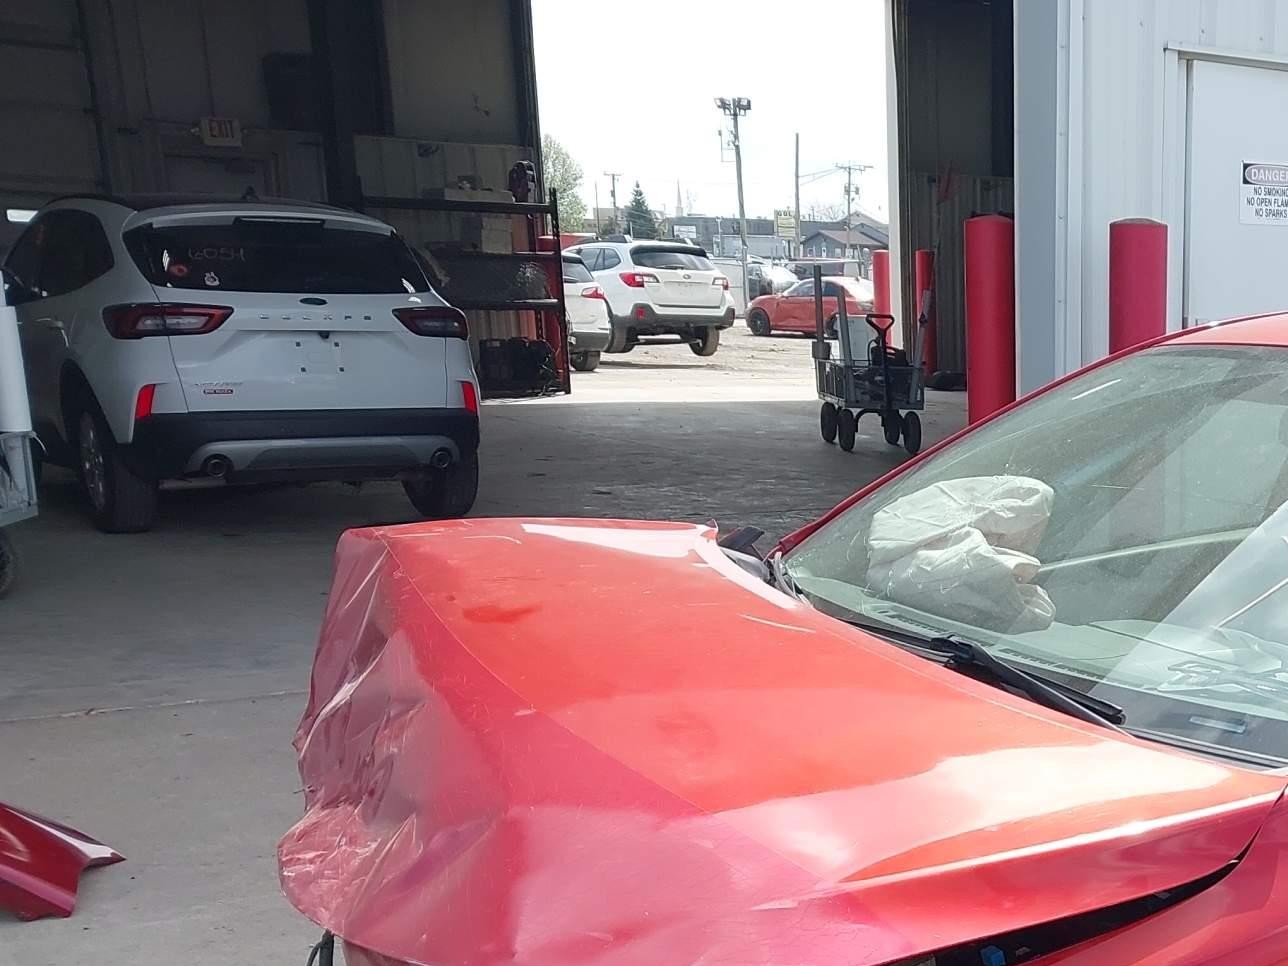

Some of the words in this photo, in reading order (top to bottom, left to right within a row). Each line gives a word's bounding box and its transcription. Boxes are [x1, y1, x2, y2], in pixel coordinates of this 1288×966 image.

[209, 119, 235, 138] EXIT
[1253, 186, 1262, 196] NO
[1246, 197, 1255, 207] NO
[1256, 197, 1272, 208] OPEN
[1255, 208, 1264, 217] NO
[1265, 208, 1288, 218] SPARKS
